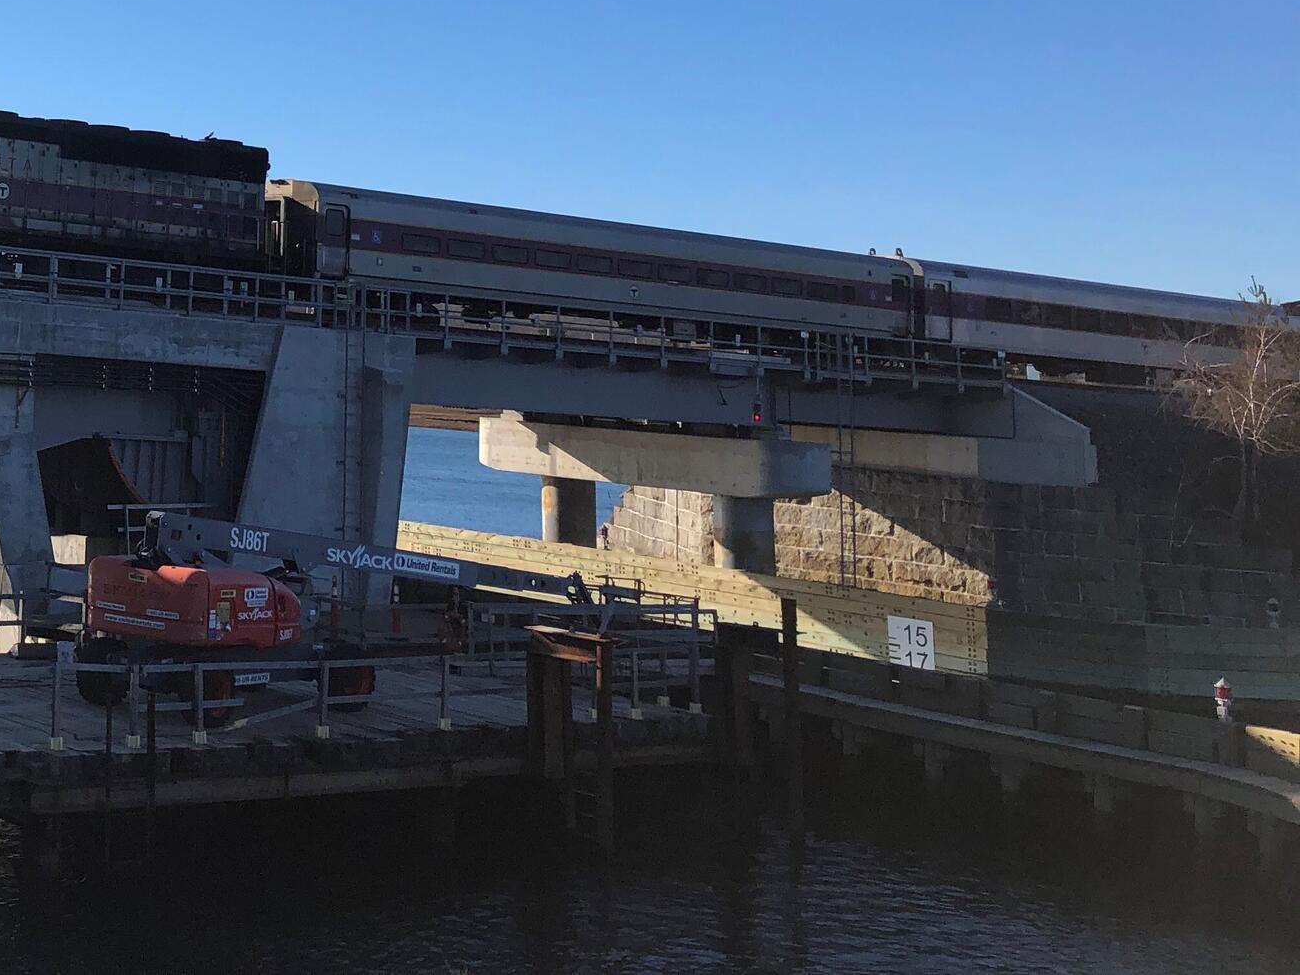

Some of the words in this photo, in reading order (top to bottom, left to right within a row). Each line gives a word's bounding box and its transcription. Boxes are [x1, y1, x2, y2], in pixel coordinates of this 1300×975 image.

[230, 527, 270, 553] SJ86T
[326, 545, 393, 570] SKYJACK
[406, 559, 430, 571] United
[431, 561, 457, 576] Rentals
[236, 608, 273, 621] SKYJACK
[903, 624, 928, 647] 15
[905, 651, 928, 669] 17
